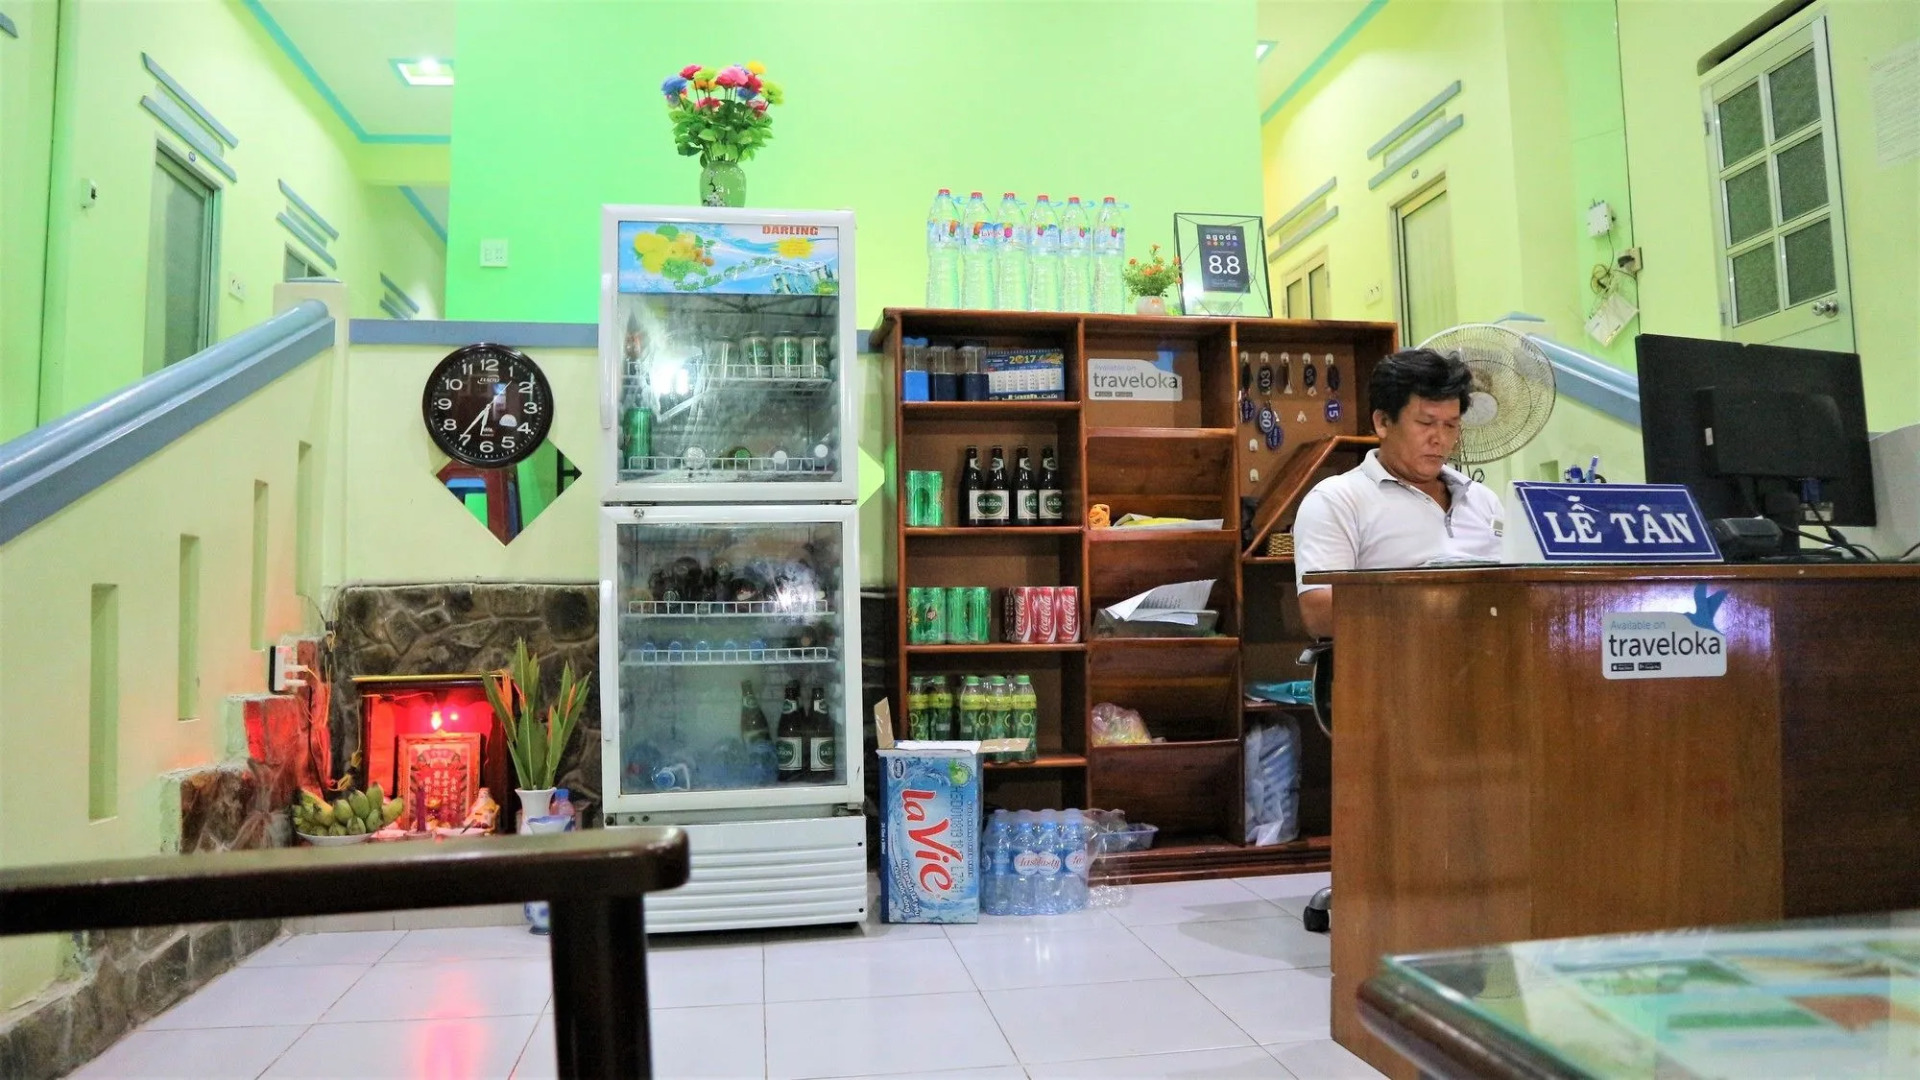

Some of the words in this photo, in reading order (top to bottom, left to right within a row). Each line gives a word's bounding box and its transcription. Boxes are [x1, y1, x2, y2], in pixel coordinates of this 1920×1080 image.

[762, 225, 819, 236] DARLING
[1208, 254, 1241, 275] 8.8
[480, 358, 499, 372] 12
[1009, 354, 1037, 364] 2017
[462, 363, 473, 375] 11
[508, 366, 514, 377] 1
[444, 378, 463, 391] 10
[1093, 372, 1178, 388] traveloka
[518, 381, 533, 394] 2
[438, 398, 452, 410] 9
[523, 402, 538, 414] 3
[1328, 403, 1339, 418] 15
[443, 418, 457, 431] 8
[516, 422, 532, 434] 4
[460, 434, 472, 446] 7
[501, 436, 515, 449] 5
[479, 441, 494, 453] 6
[1543, 495, 1602, 544] LỄ
[1610, 504, 1697, 544] TÂN
[1610, 620, 1651, 630] Available
[1654, 622, 1666, 630] on
[1608, 631, 1721, 657] traveloka
